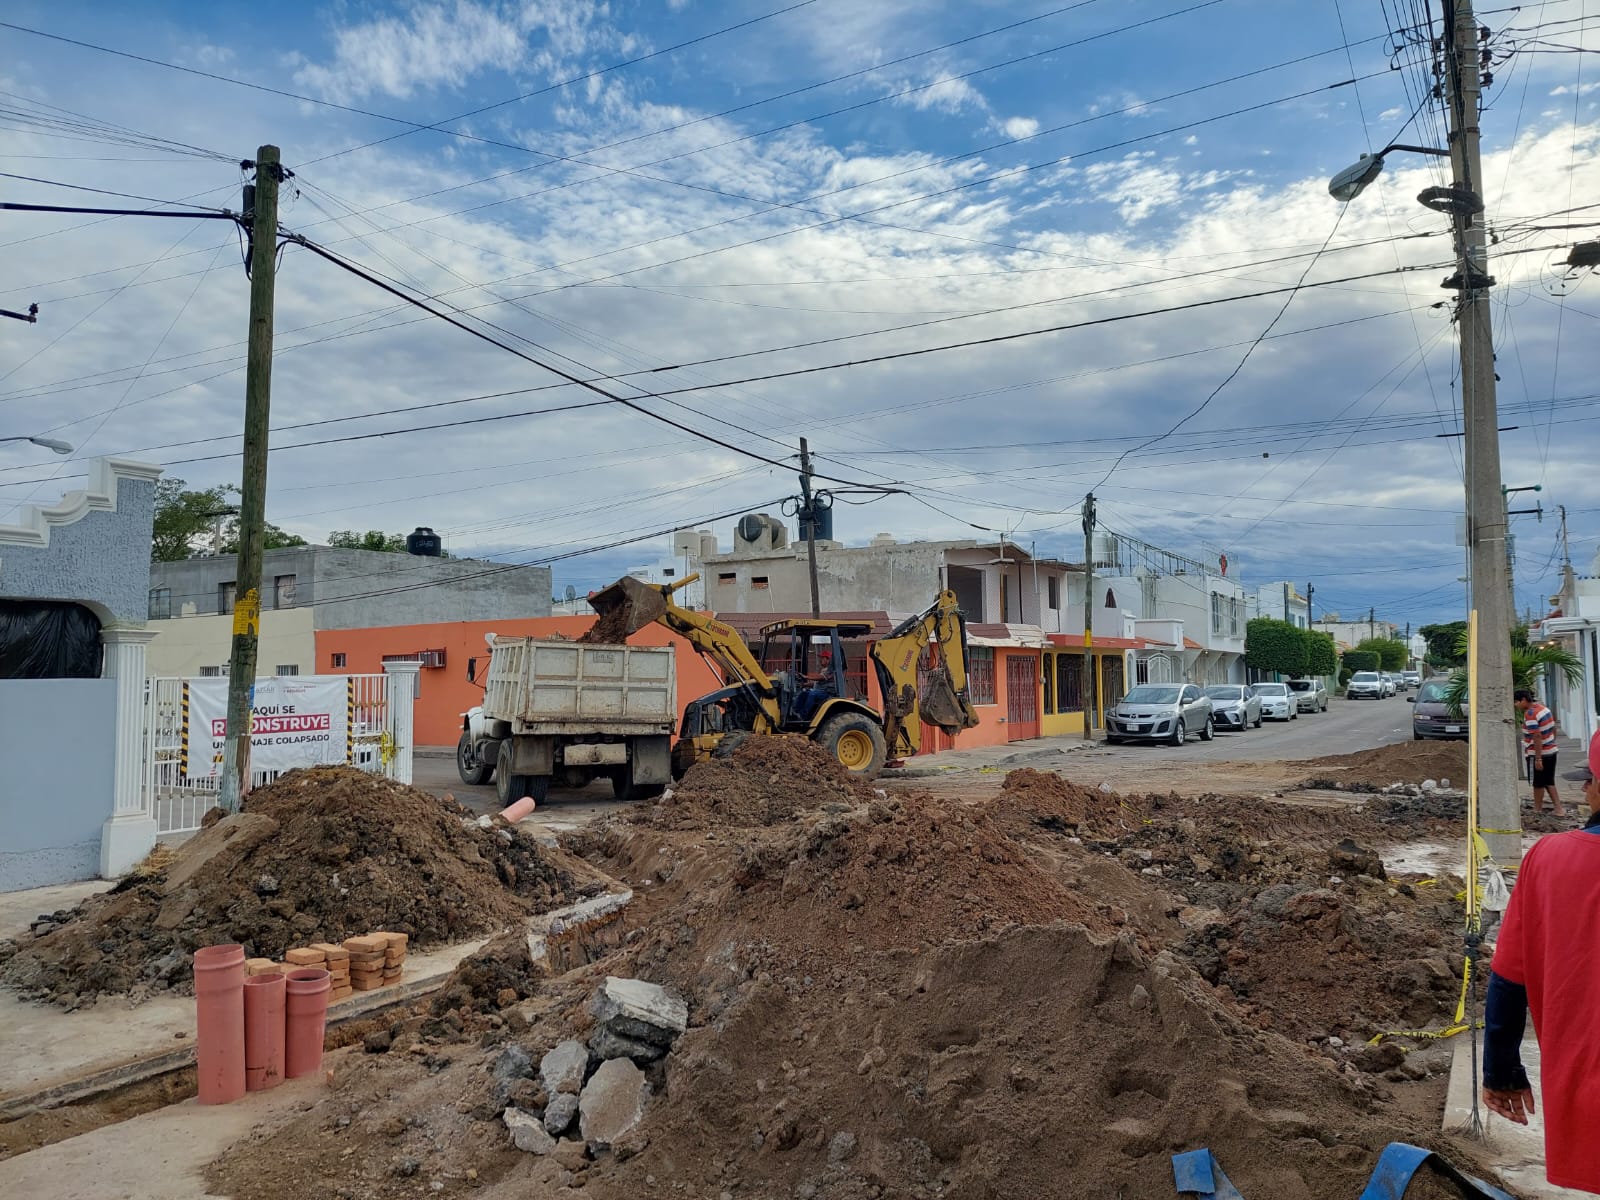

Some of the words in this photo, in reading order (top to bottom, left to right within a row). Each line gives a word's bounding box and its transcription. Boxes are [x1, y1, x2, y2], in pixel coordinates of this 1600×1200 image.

[252, 704, 279, 716] AQUÍ
[282, 705, 295, 714] SE
[213, 715, 329, 734] RONSTRUYE
[275, 734, 330, 745] COLAPSADO
